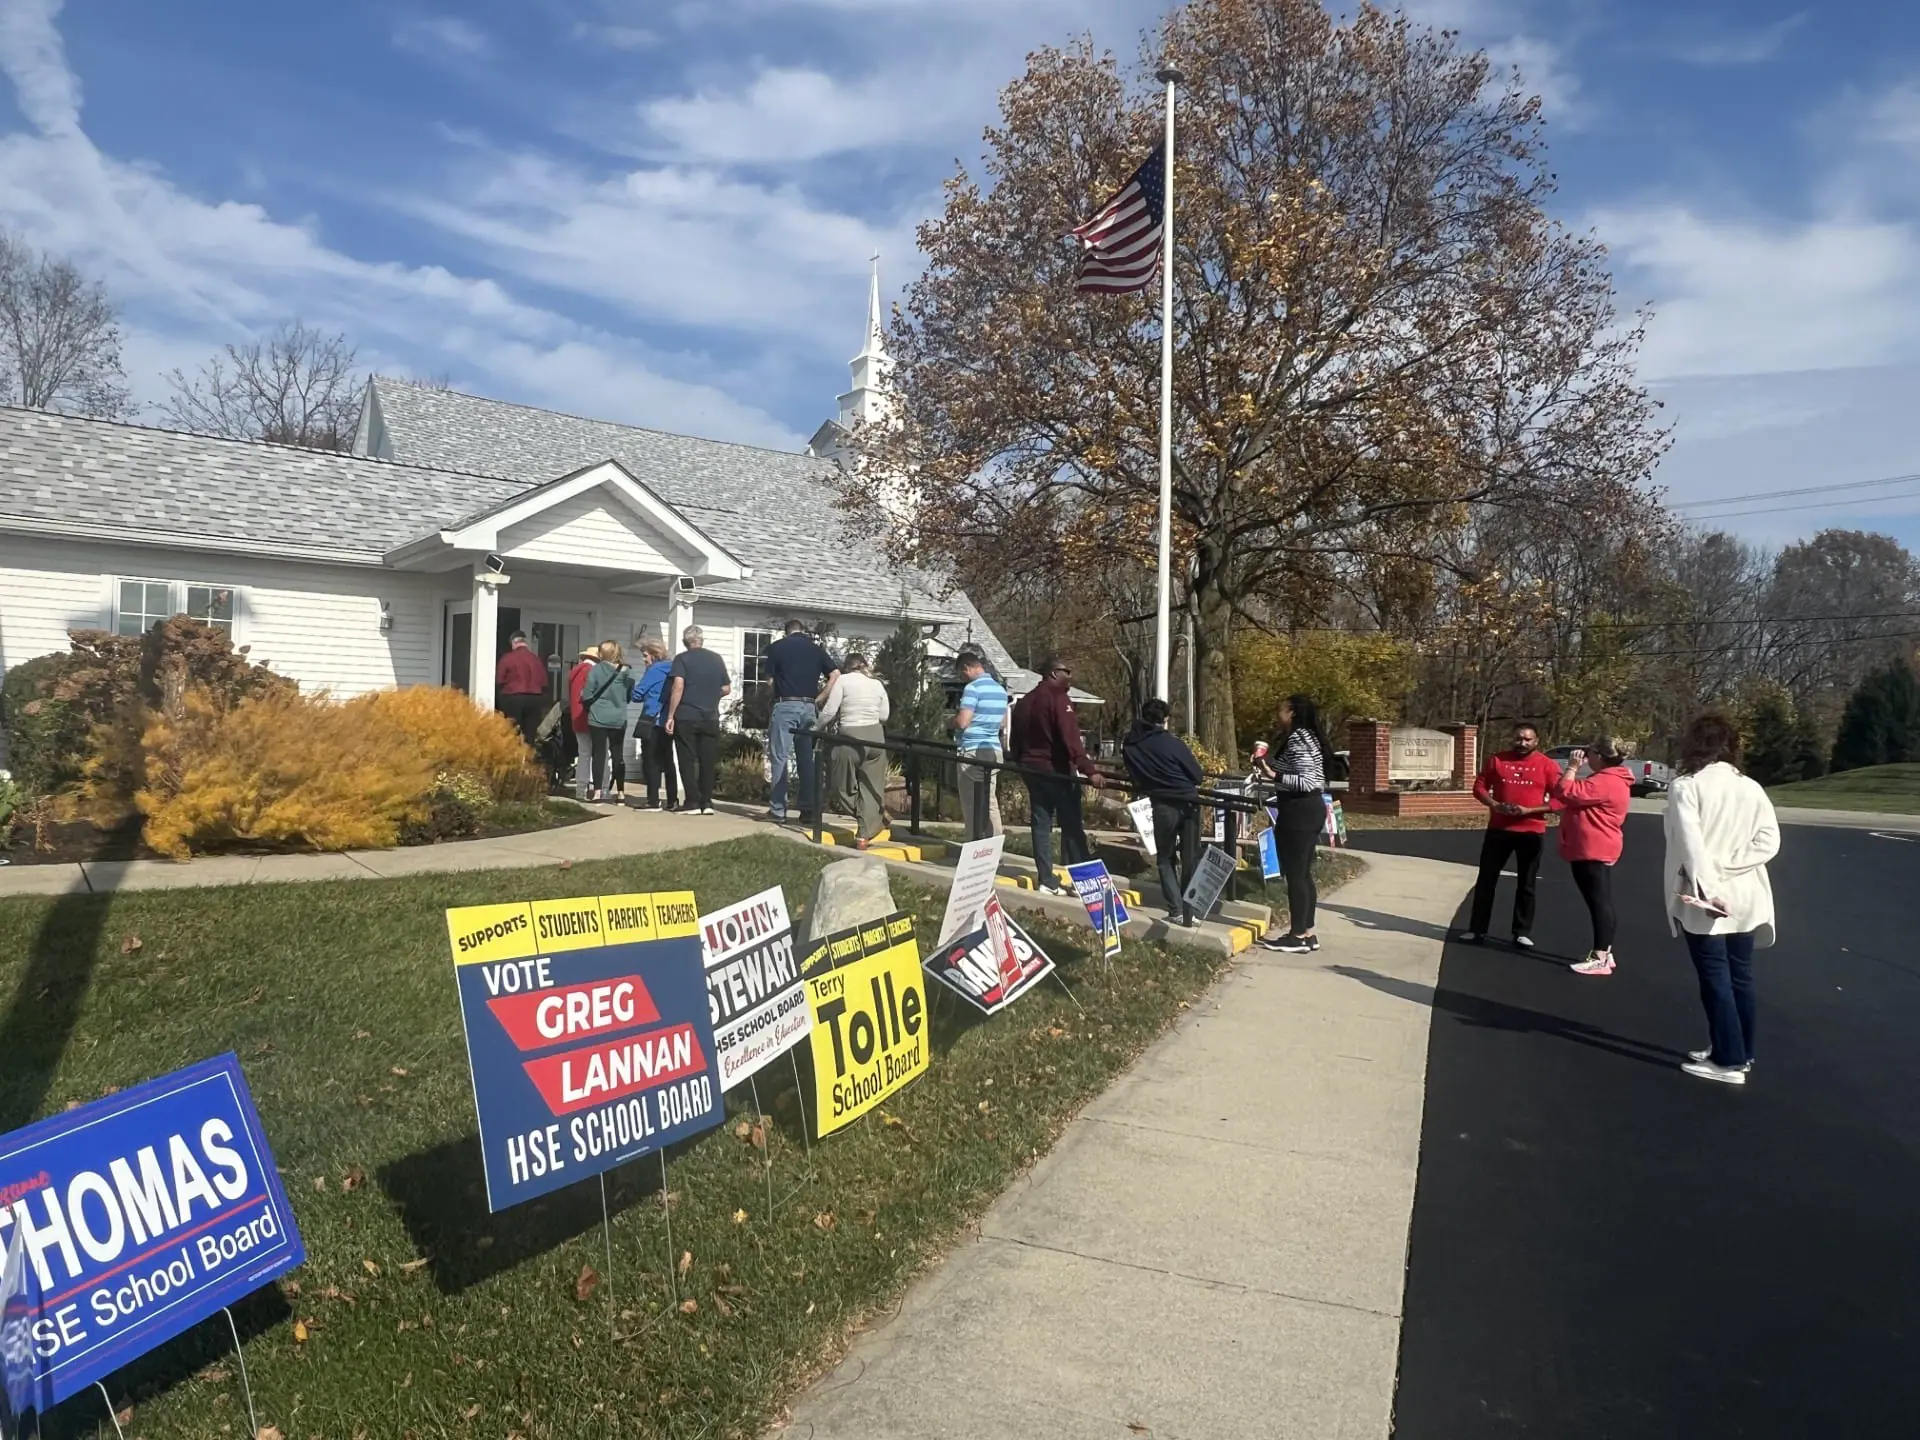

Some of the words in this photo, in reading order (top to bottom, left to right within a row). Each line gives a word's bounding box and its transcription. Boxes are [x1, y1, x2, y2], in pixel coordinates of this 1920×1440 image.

[458, 914, 528, 953] SUPPORTS
[539, 910, 600, 939] STUDENTS
[607, 906, 650, 931] PARENTS
[656, 903, 697, 925] TEACHERS
[705, 901, 774, 957] JOHN
[944, 924, 1034, 997] BANS
[482, 958, 555, 996] VOTE
[811, 974, 845, 1000] Terry
[536, 982, 635, 1039] GREG
[737, 1008, 778, 1042] SCHOOL
[777, 989, 805, 1018] BOARD
[816, 971, 922, 1079] Tolle
[562, 1030, 693, 1104] LANNAN
[832, 1060, 883, 1119] School
[885, 1035, 921, 1086] Board
[507, 1124, 565, 1185] HSE
[570, 1095, 656, 1163] SCHOOL
[658, 1076, 713, 1131] BOARD
[32, 1303, 88, 1358] SE
[91, 1248, 196, 1327] School
[197, 1206, 278, 1272] Board
